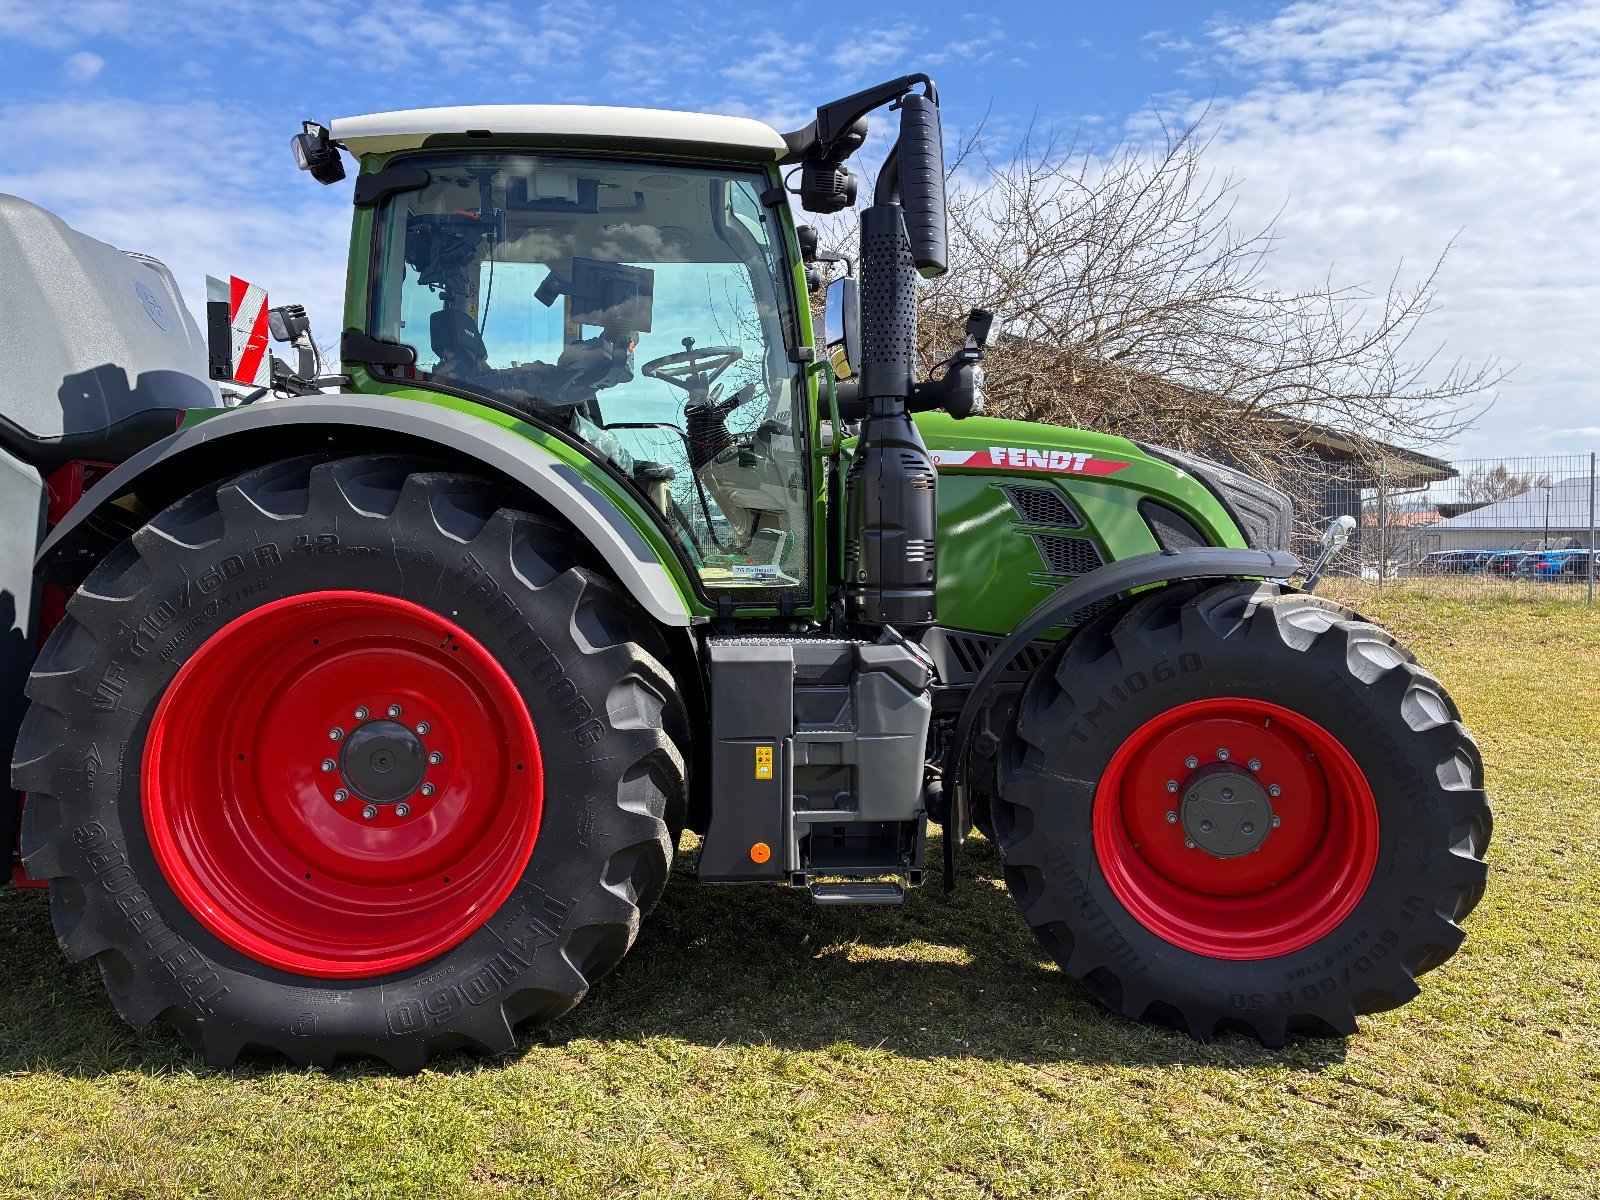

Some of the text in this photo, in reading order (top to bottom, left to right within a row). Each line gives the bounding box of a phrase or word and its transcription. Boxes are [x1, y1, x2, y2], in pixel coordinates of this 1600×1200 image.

[988, 446, 1093, 471] FENDT
[93, 659, 129, 712] VF
[253, 542, 283, 569] R
[291, 533, 341, 556] 42
[462, 551, 607, 748] TRELLEBORG
[1066, 652, 1203, 744] TM1060
[73, 821, 231, 1015] TRELLEBORG
[385, 894, 580, 1036] TM1060
[1302, 930, 1400, 999] 600/60
[1230, 993, 1267, 1009] 30
